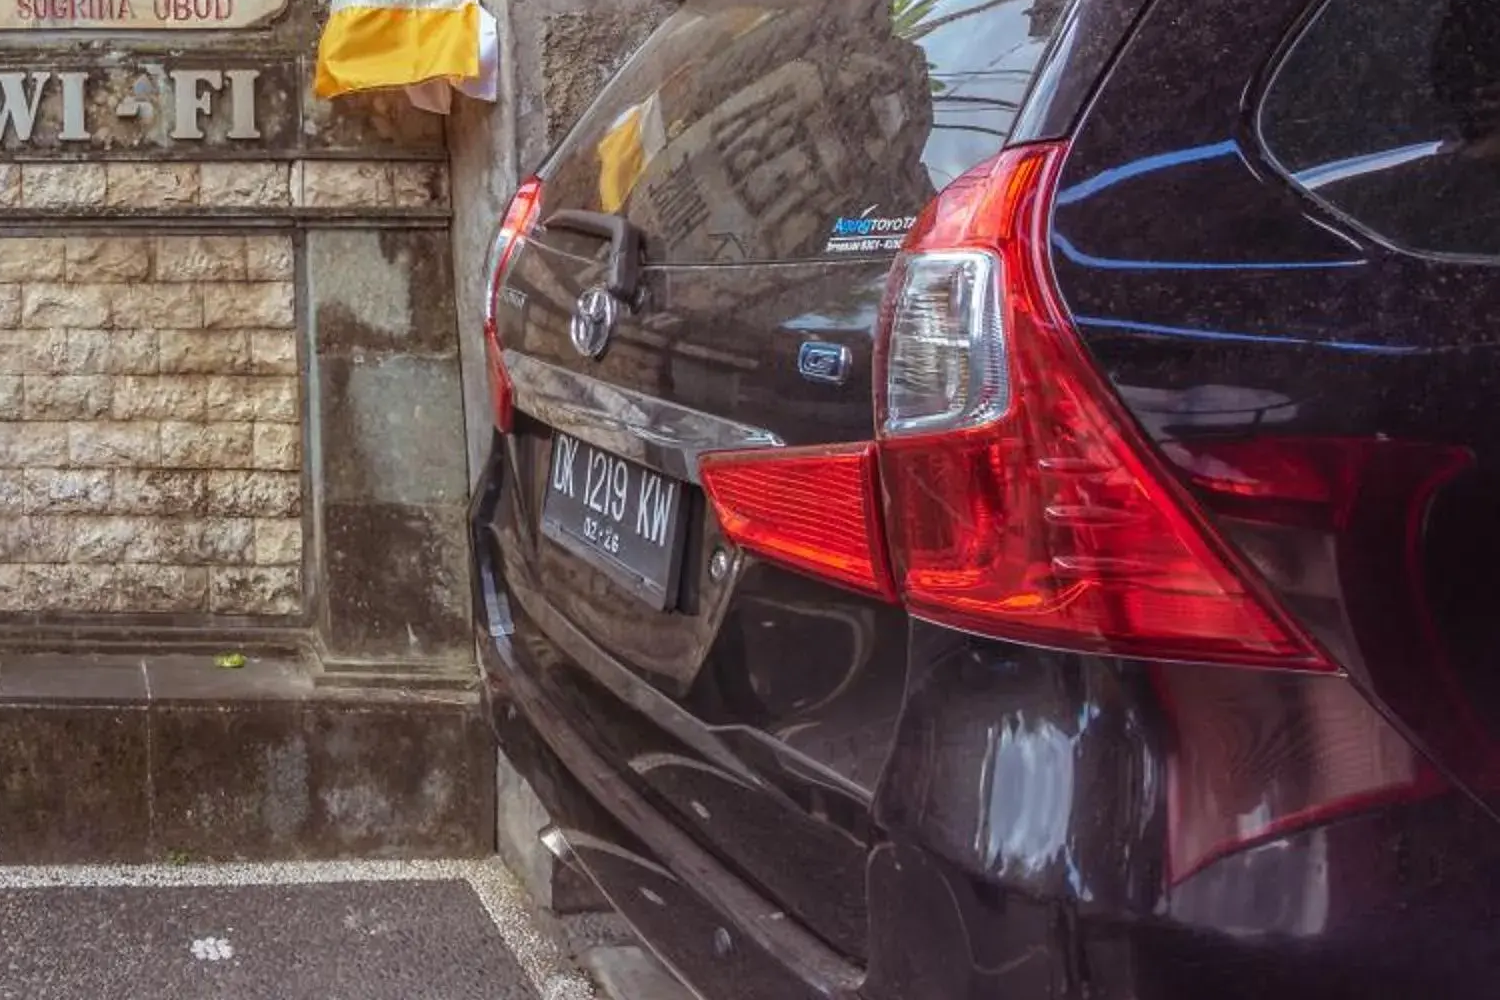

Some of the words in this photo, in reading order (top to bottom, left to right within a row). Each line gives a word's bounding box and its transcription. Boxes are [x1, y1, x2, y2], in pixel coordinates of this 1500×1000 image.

[553, 433, 579, 498] DK
[583, 447, 629, 521] 1219
[636, 469, 675, 547] KW
